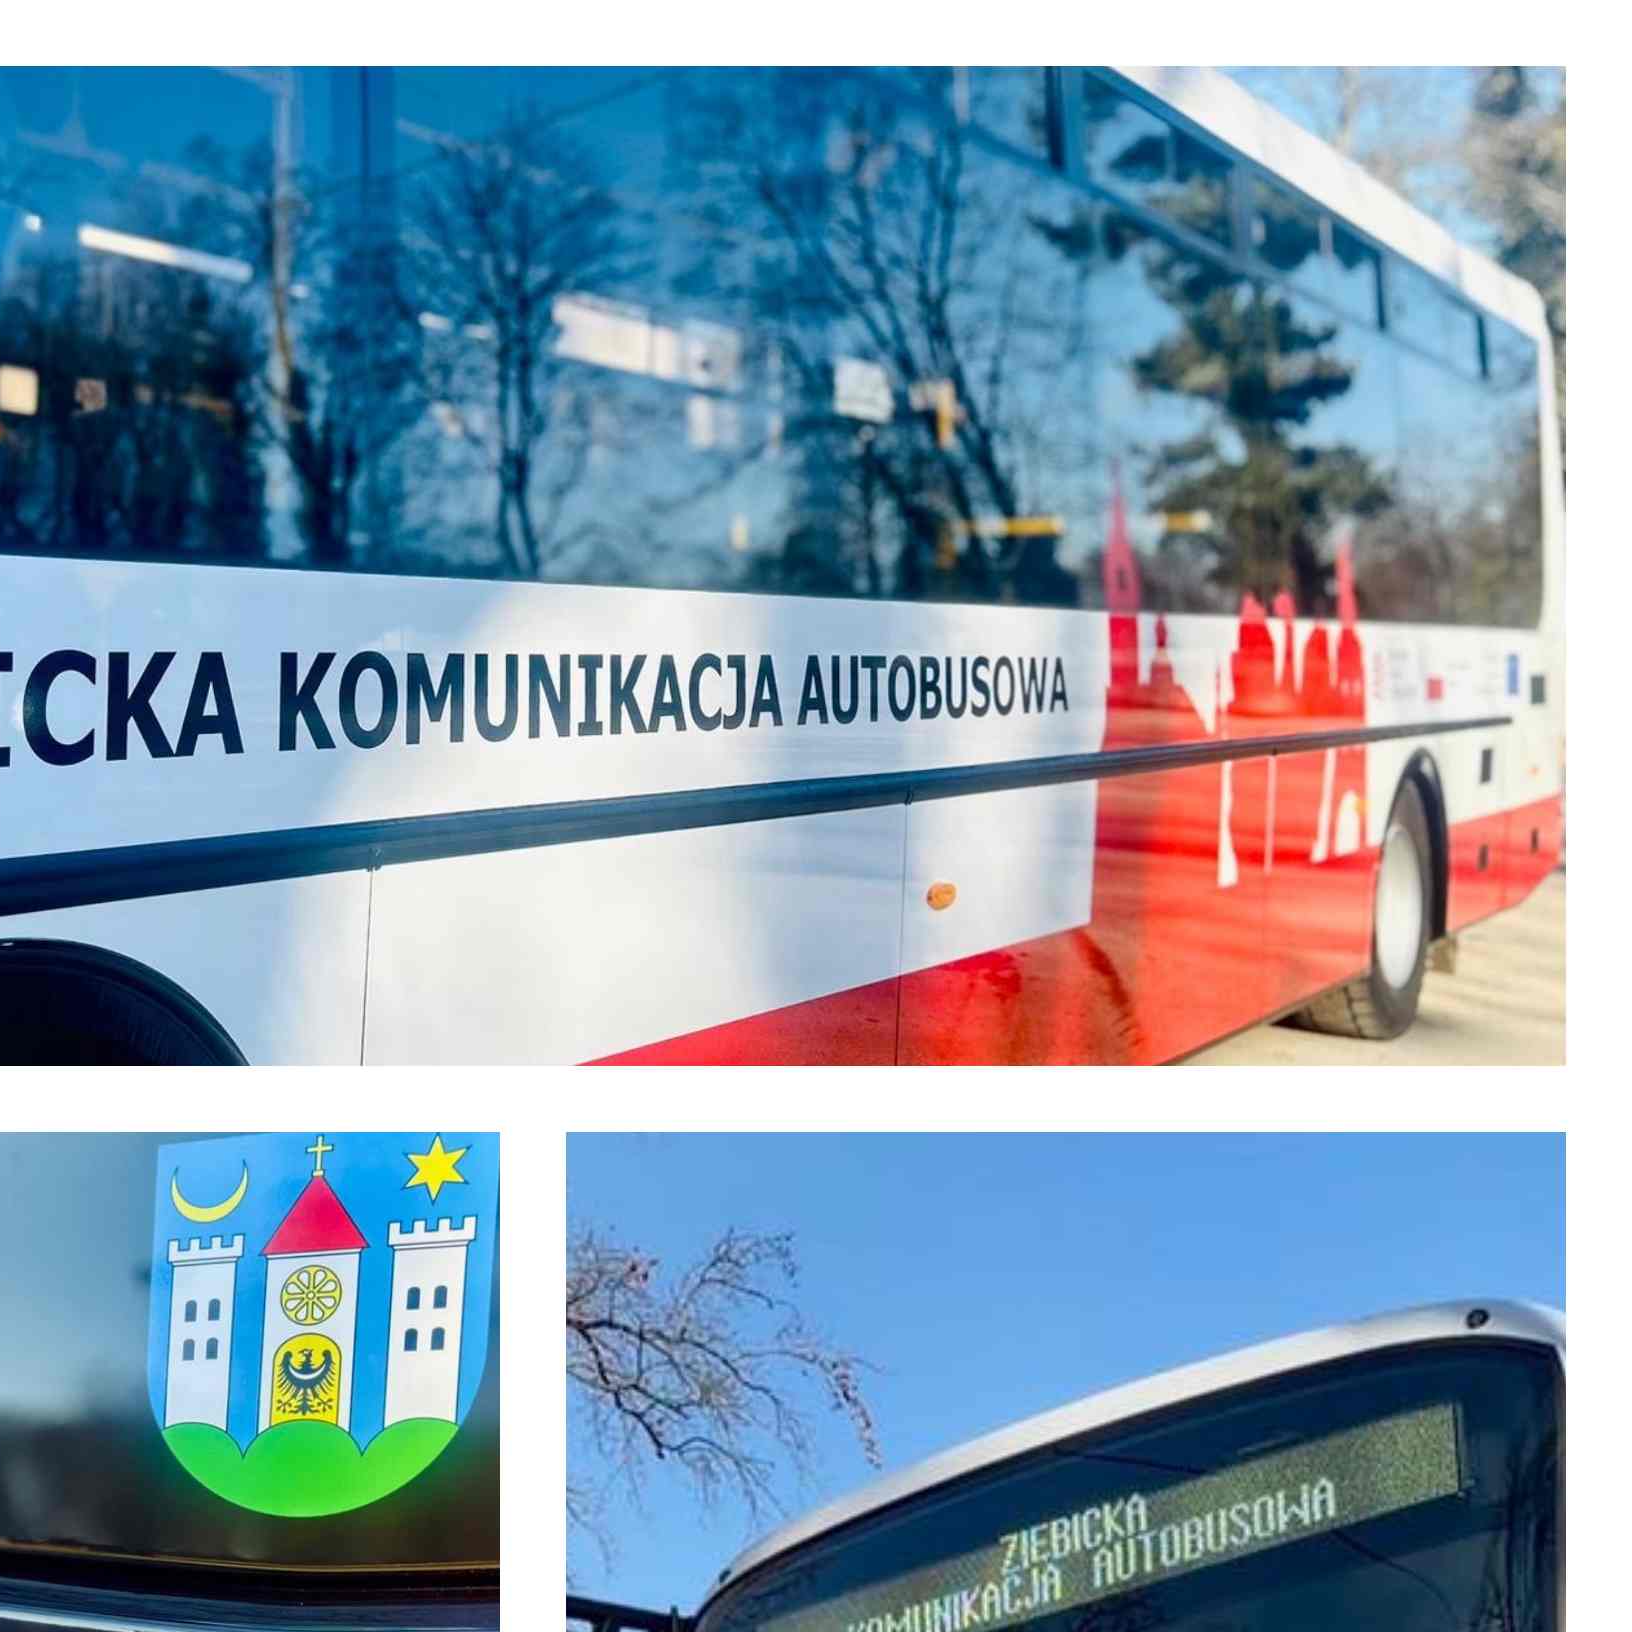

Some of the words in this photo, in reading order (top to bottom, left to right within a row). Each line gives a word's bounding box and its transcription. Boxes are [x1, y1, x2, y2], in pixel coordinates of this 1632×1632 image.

[278, 650, 785, 752] KOMUNIKACJA
[796, 653, 1070, 727] AUTOBUSOWA
[1092, 1476, 1336, 1589] AUTOBUSOWA
